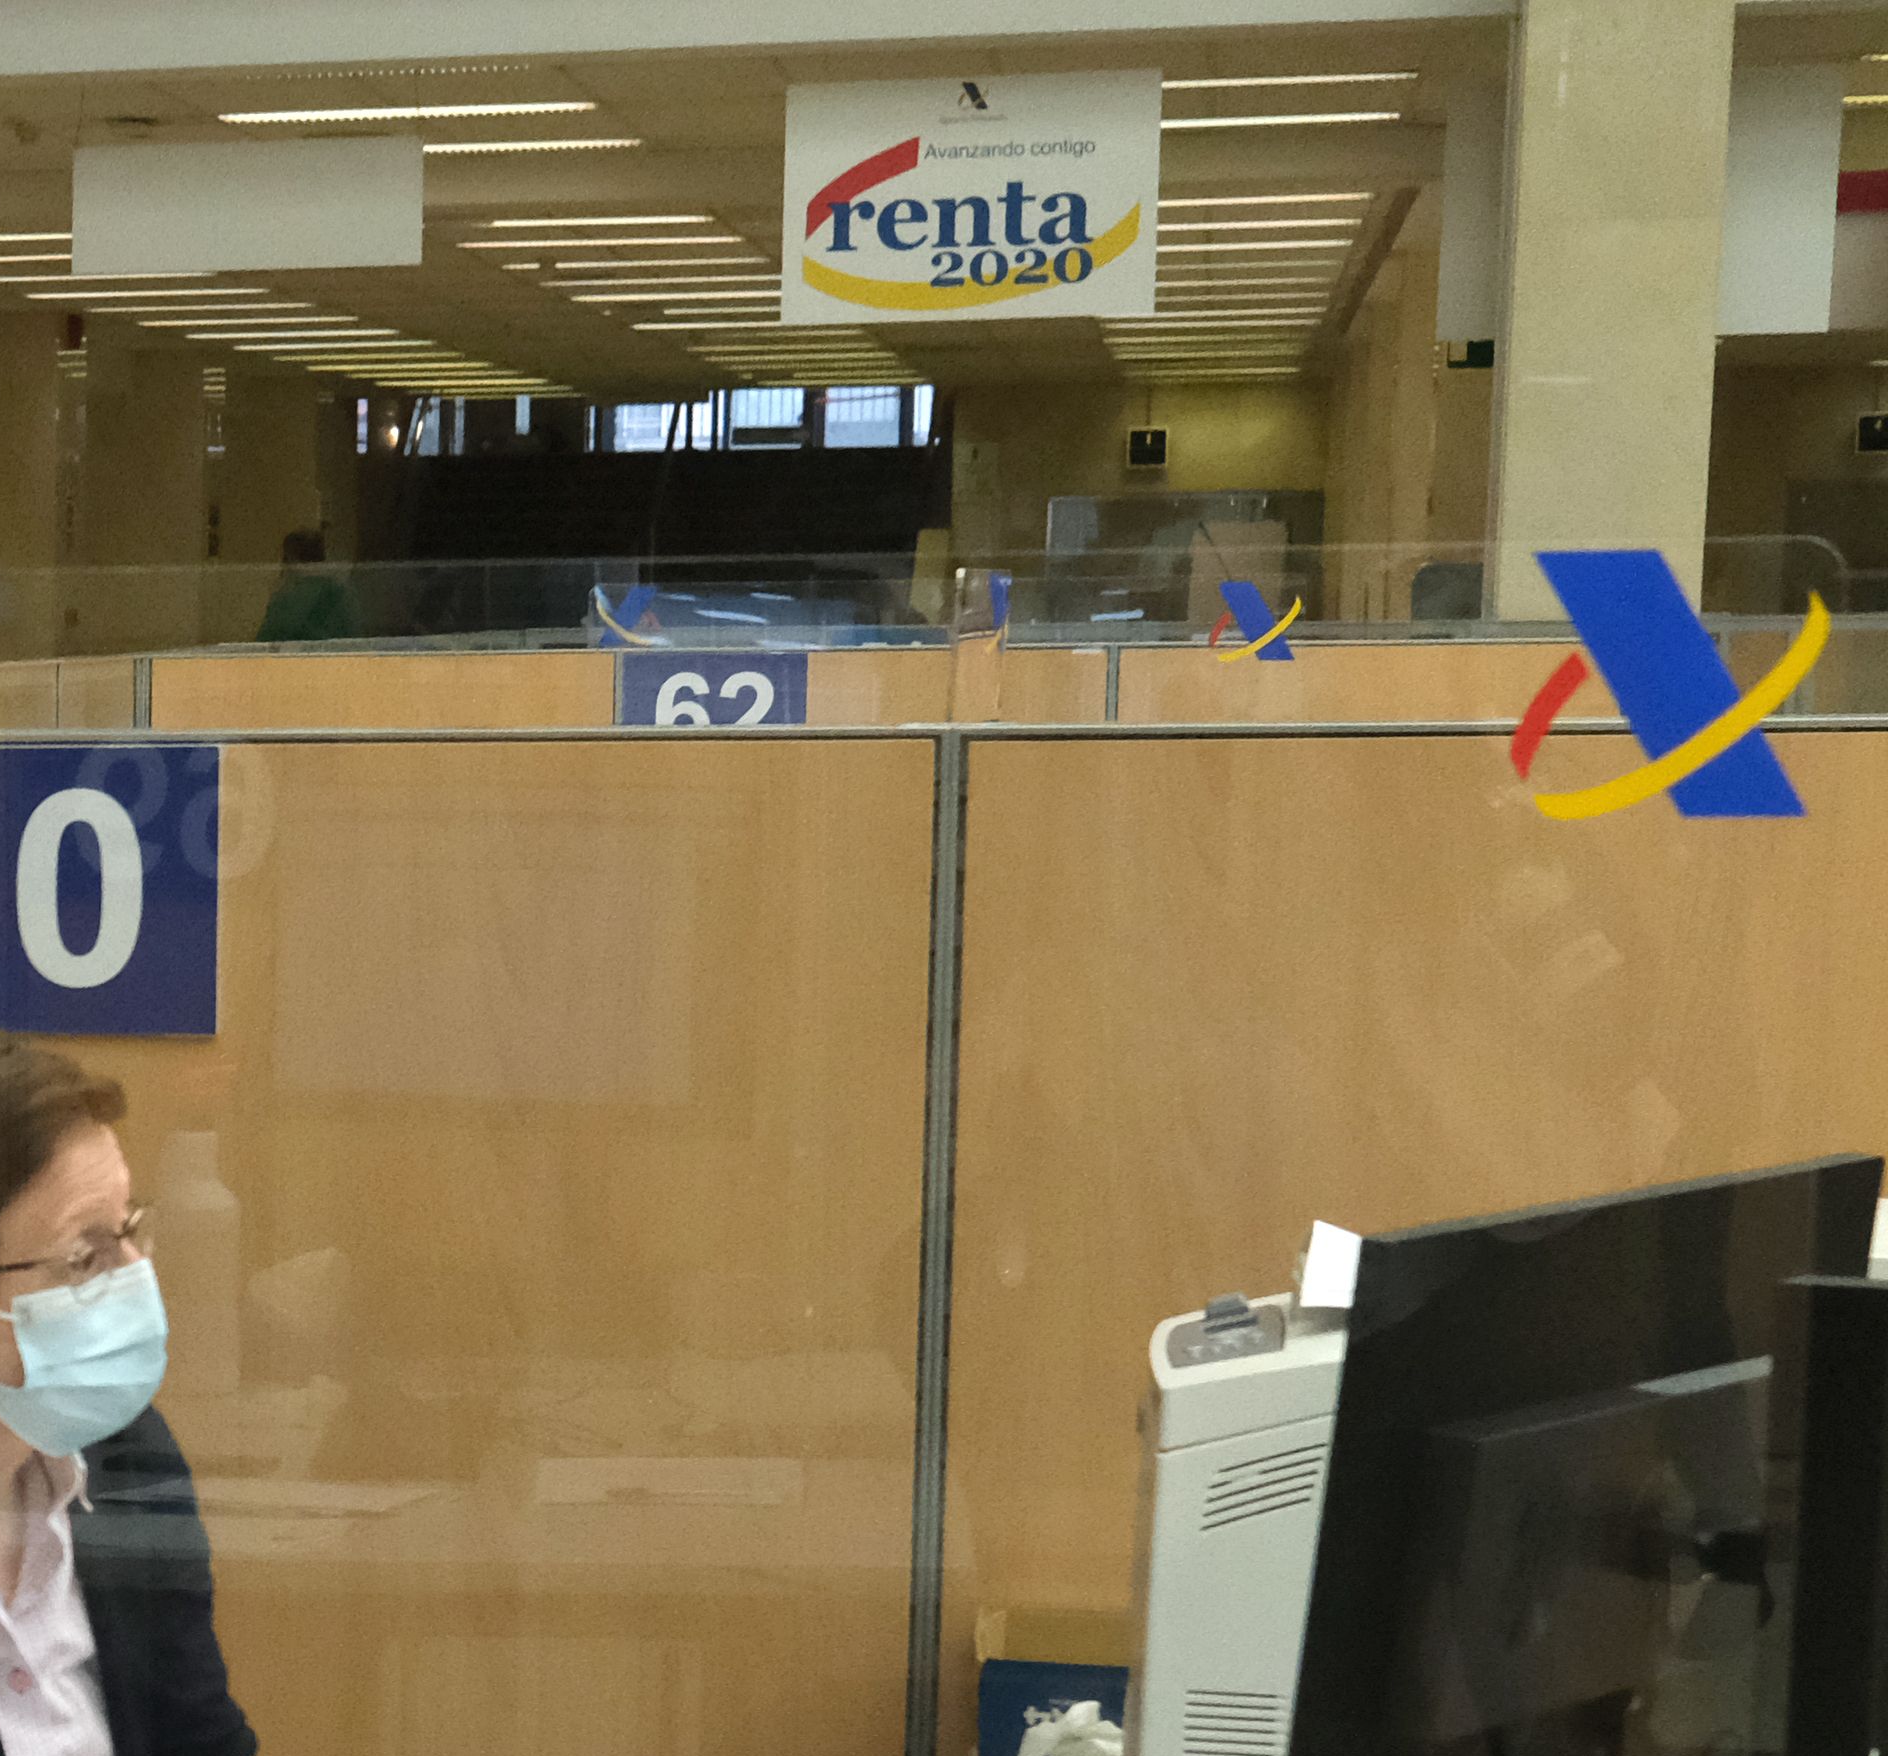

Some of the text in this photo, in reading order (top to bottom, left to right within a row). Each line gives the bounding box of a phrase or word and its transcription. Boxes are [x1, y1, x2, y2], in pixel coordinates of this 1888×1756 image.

[924, 136, 1096, 160] Avanzando contigo
[826, 180, 1095, 253] renta
[930, 246, 1094, 288] 2020
[655, 671, 775, 726] 62
